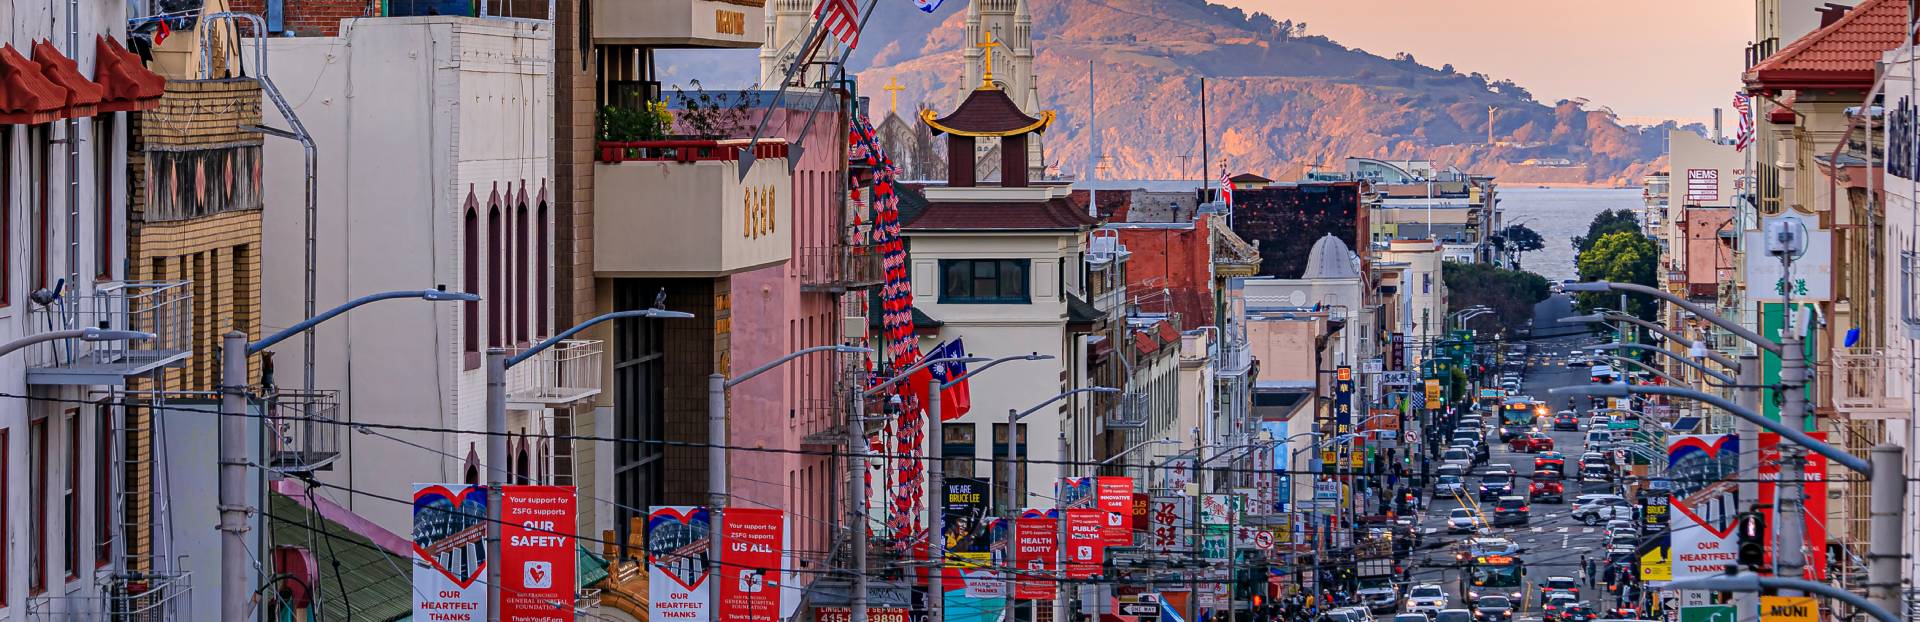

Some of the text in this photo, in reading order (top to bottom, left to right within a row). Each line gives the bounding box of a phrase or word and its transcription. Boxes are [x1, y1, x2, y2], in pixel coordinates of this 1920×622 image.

[1689, 170, 1717, 178] NEMS
[950, 484, 972, 493] WE ARE
[528, 497, 556, 505] support
[949, 494, 980, 503] BRUCE LEE
[1648, 496, 1668, 506] WE ARE
[523, 521, 554, 532] OUR
[511, 536, 566, 547] SAFETY
[732, 543, 772, 553] US ALL
[1680, 553, 1737, 561] HEARTFELT
[439, 591, 460, 599] OUR
[1771, 605, 1808, 617] MUNI
[429, 613, 470, 622] THANKS
